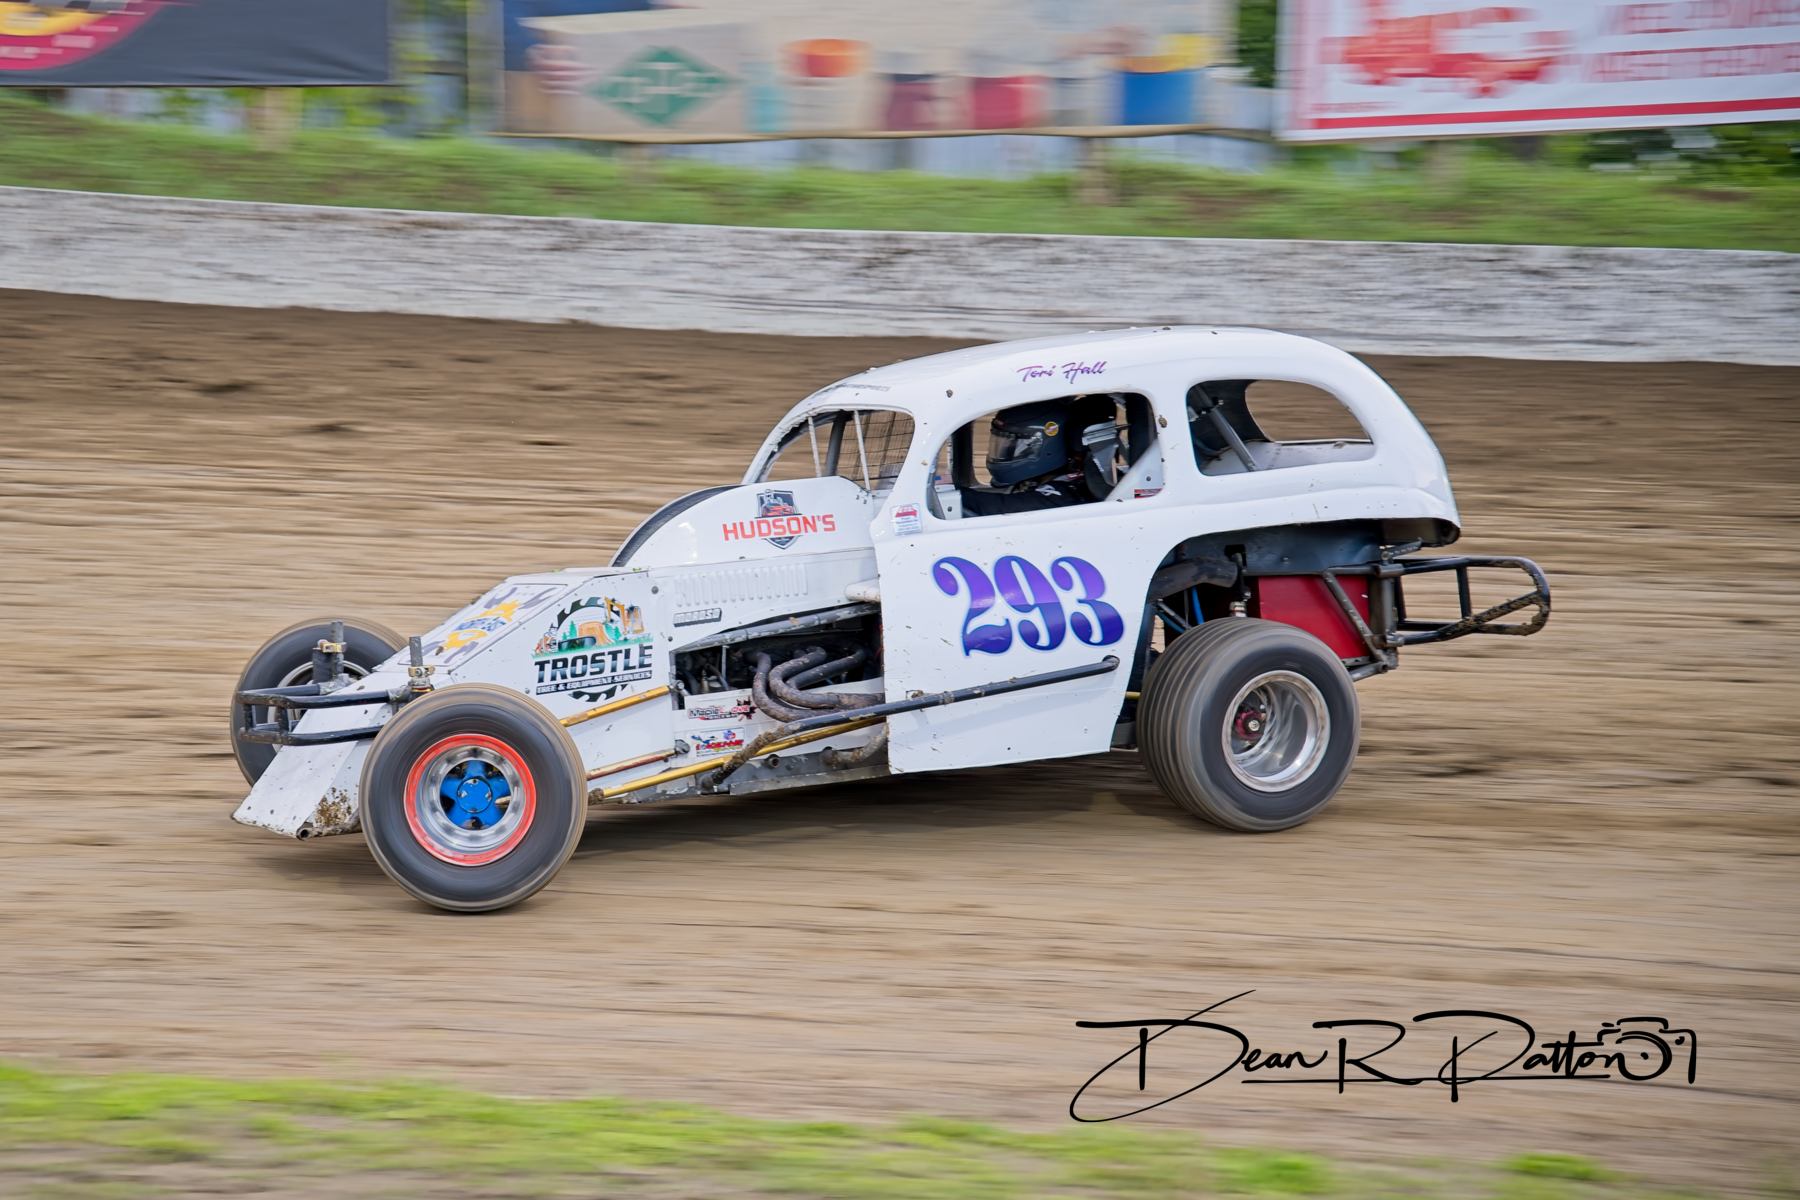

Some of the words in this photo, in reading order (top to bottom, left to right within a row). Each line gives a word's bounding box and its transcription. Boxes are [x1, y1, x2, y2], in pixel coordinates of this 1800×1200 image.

[1017, 364, 1056, 383] Tori
[1061, 361, 1107, 385] Hall
[722, 513, 836, 543] HUDSON'S
[931, 555, 1125, 657] 293
[534, 643, 654, 684] TROSTLE
